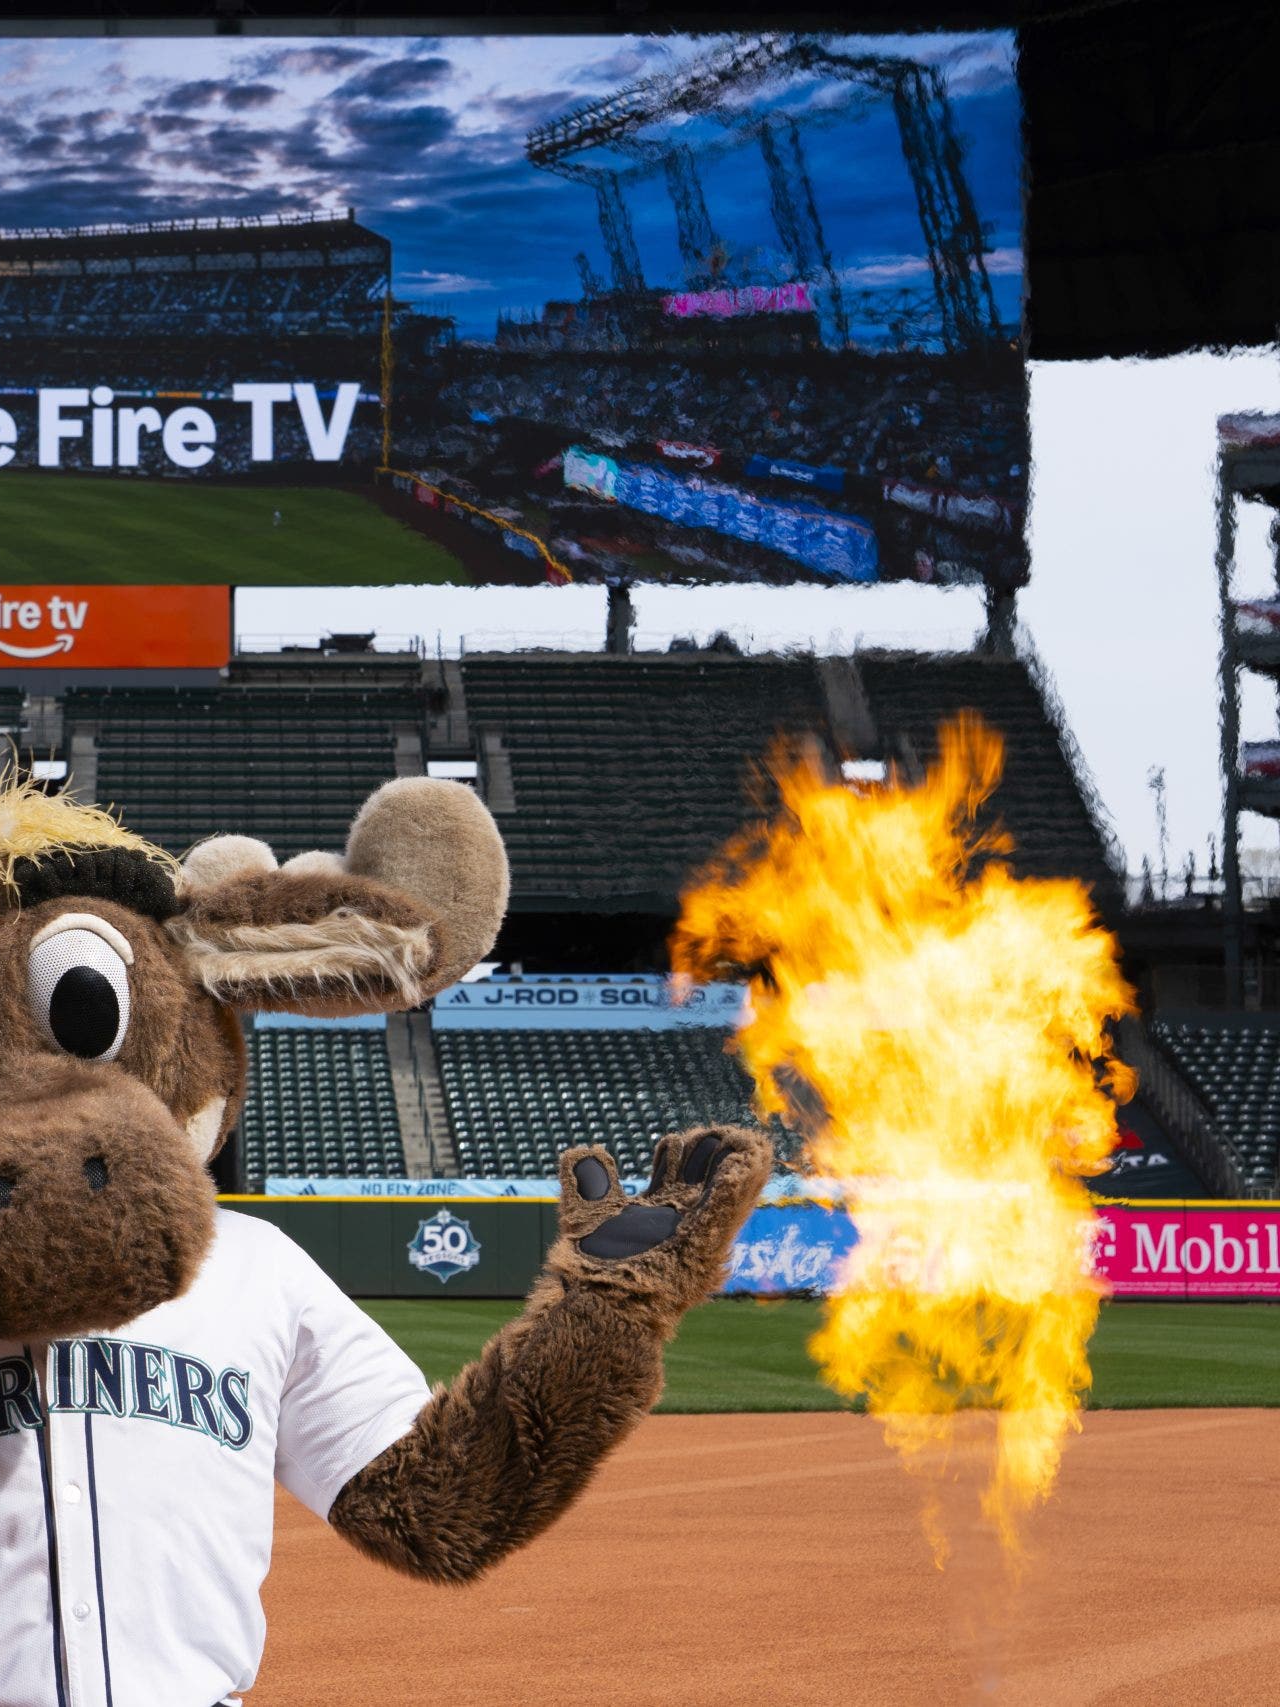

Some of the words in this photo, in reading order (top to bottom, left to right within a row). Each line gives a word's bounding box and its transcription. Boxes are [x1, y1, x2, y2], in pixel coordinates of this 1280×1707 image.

[39, 386, 217, 468] Fire
[232, 382, 361, 461] TV
[47, 595, 88, 629] tv
[485, 989, 578, 1005] J-ROD
[600, 988, 706, 1006] SQUD
[361, 1183, 381, 1195] NO
[387, 1183, 411, 1195] FLY
[417, 1183, 456, 1195] ZONE
[423, 1225, 467, 1254] 50
